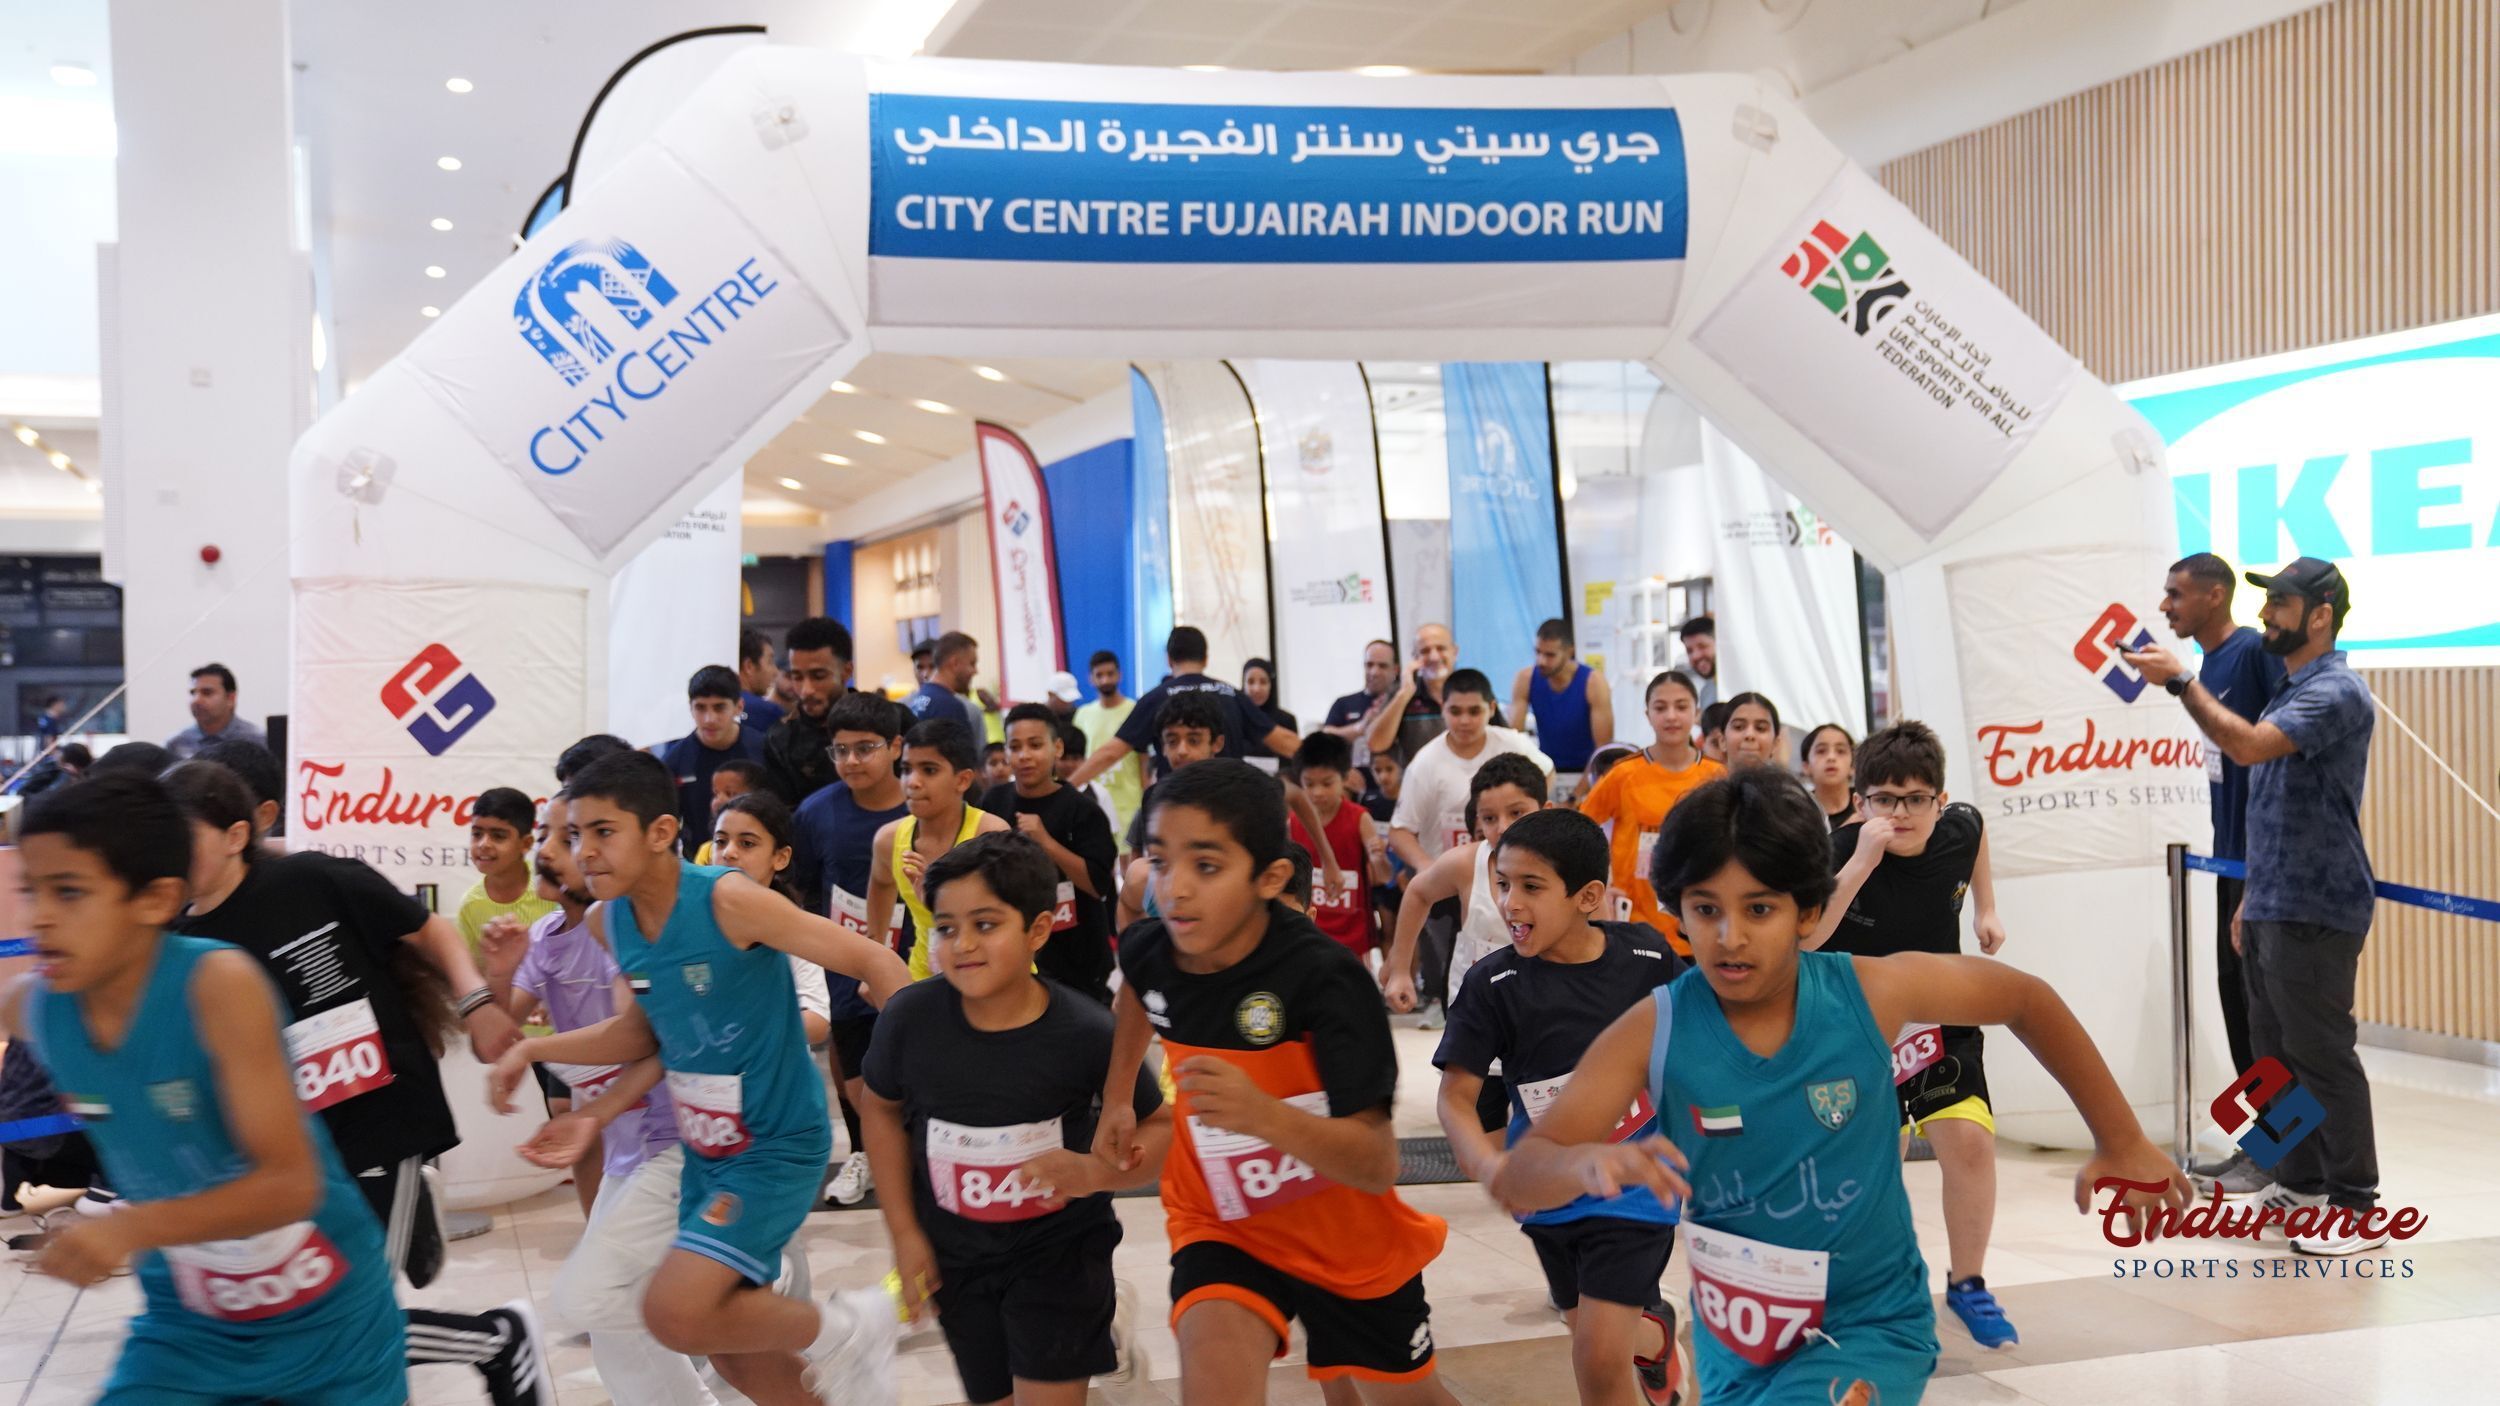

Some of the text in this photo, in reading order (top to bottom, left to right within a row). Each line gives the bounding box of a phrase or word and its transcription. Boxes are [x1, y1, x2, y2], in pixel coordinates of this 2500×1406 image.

[894, 115, 1661, 174] جري سيتي سنتر الفجيرة الداخلي
[896, 195, 1664, 236] CITY CENTRE FUJAIRAH INDOOR RUN
[1876, 340, 1956, 410] FEDERATION
[1889, 326, 2016, 438] UAE SPORTS FOR ALL
[2172, 437, 2500, 566] IKE
[1977, 718, 2206, 787] Enduranc
[2002, 789, 2118, 817] SPORTS
[294, 1041, 382, 1101] 840
[1236, 1153, 1319, 1198] 84
[1698, 1280, 1812, 1351] 807
